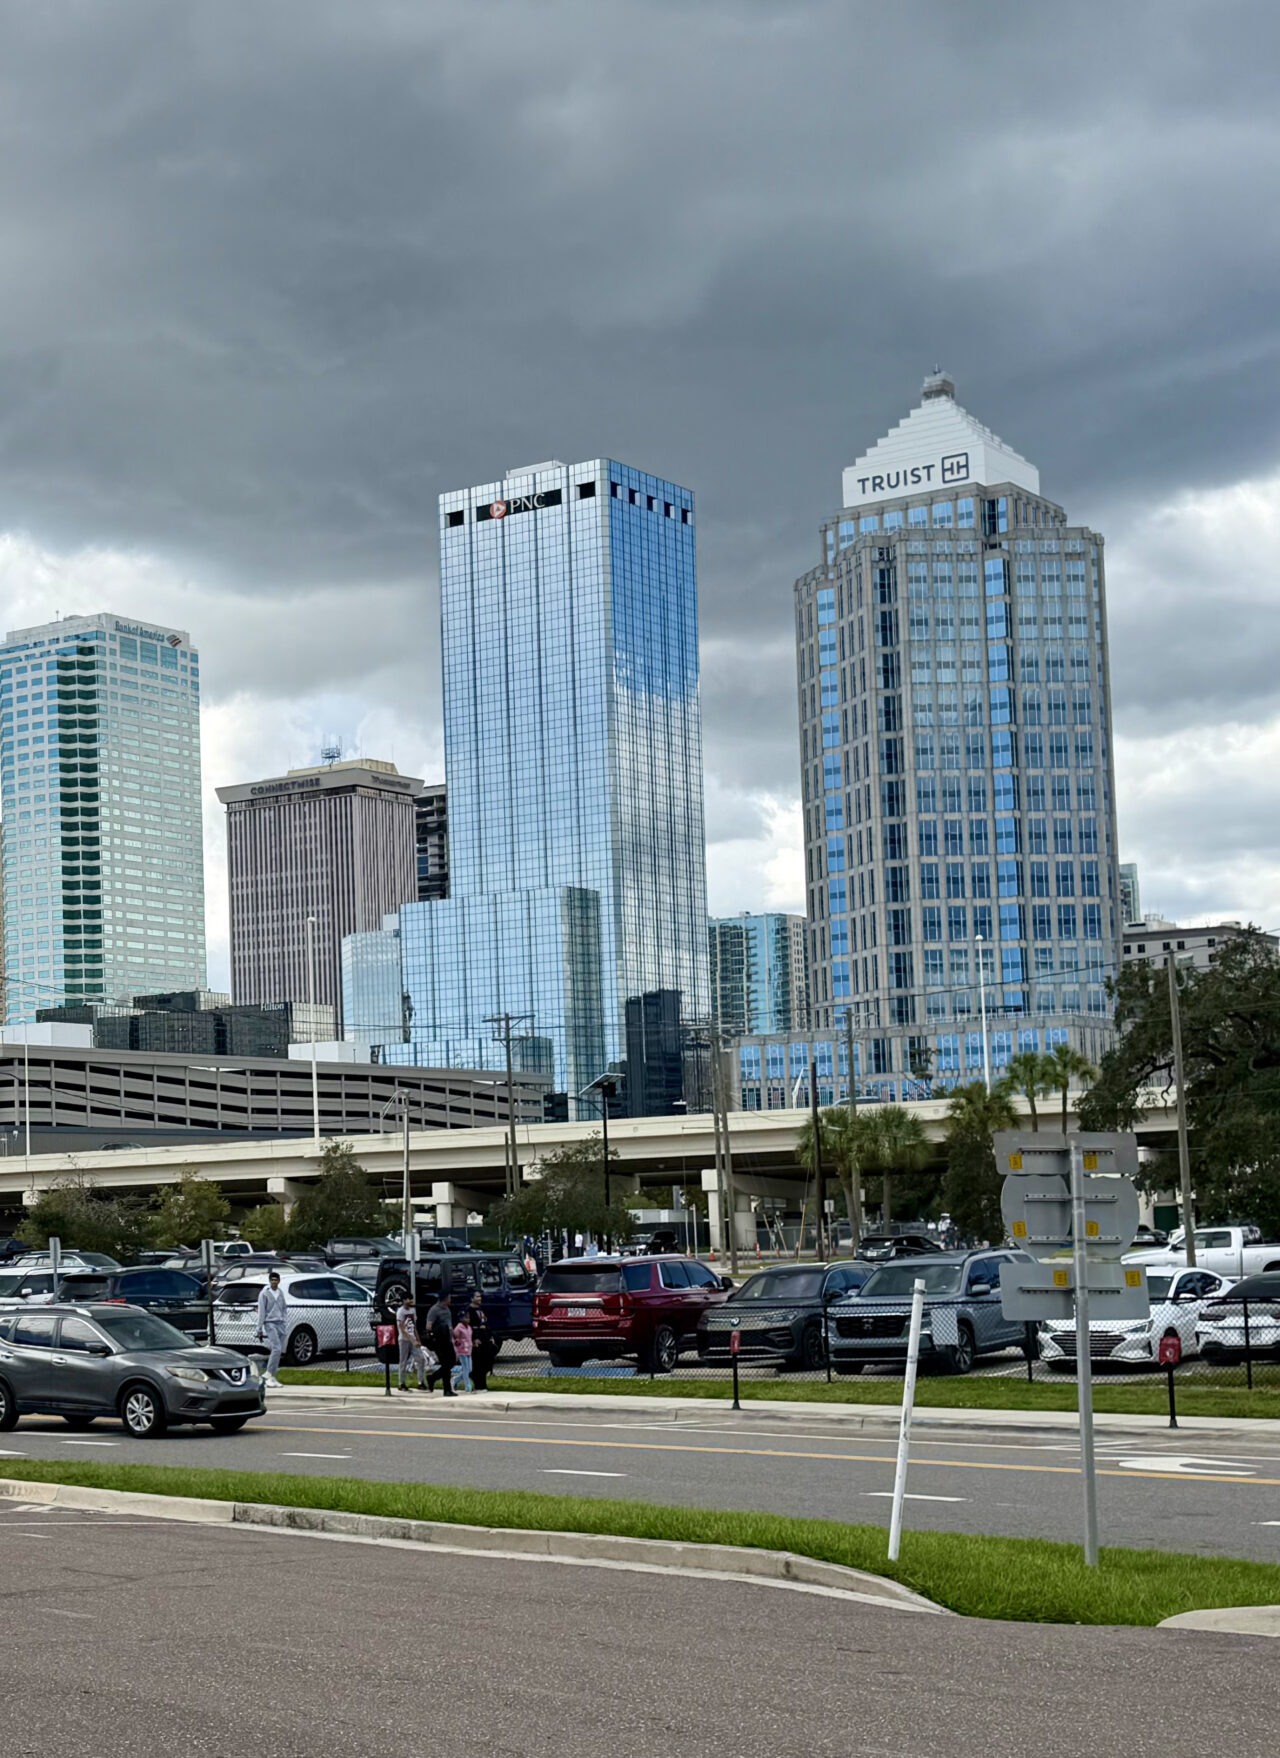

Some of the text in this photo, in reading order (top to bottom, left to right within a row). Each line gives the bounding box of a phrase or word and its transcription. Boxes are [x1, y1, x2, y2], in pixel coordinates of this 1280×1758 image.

[857, 464, 935, 494] TRUIST
[510, 494, 545, 514] PNC
[115, 620, 165, 642] Bank of America
[250, 777, 320, 795] CONNECTWISE
[260, 1001, 285, 1011] Hilton
